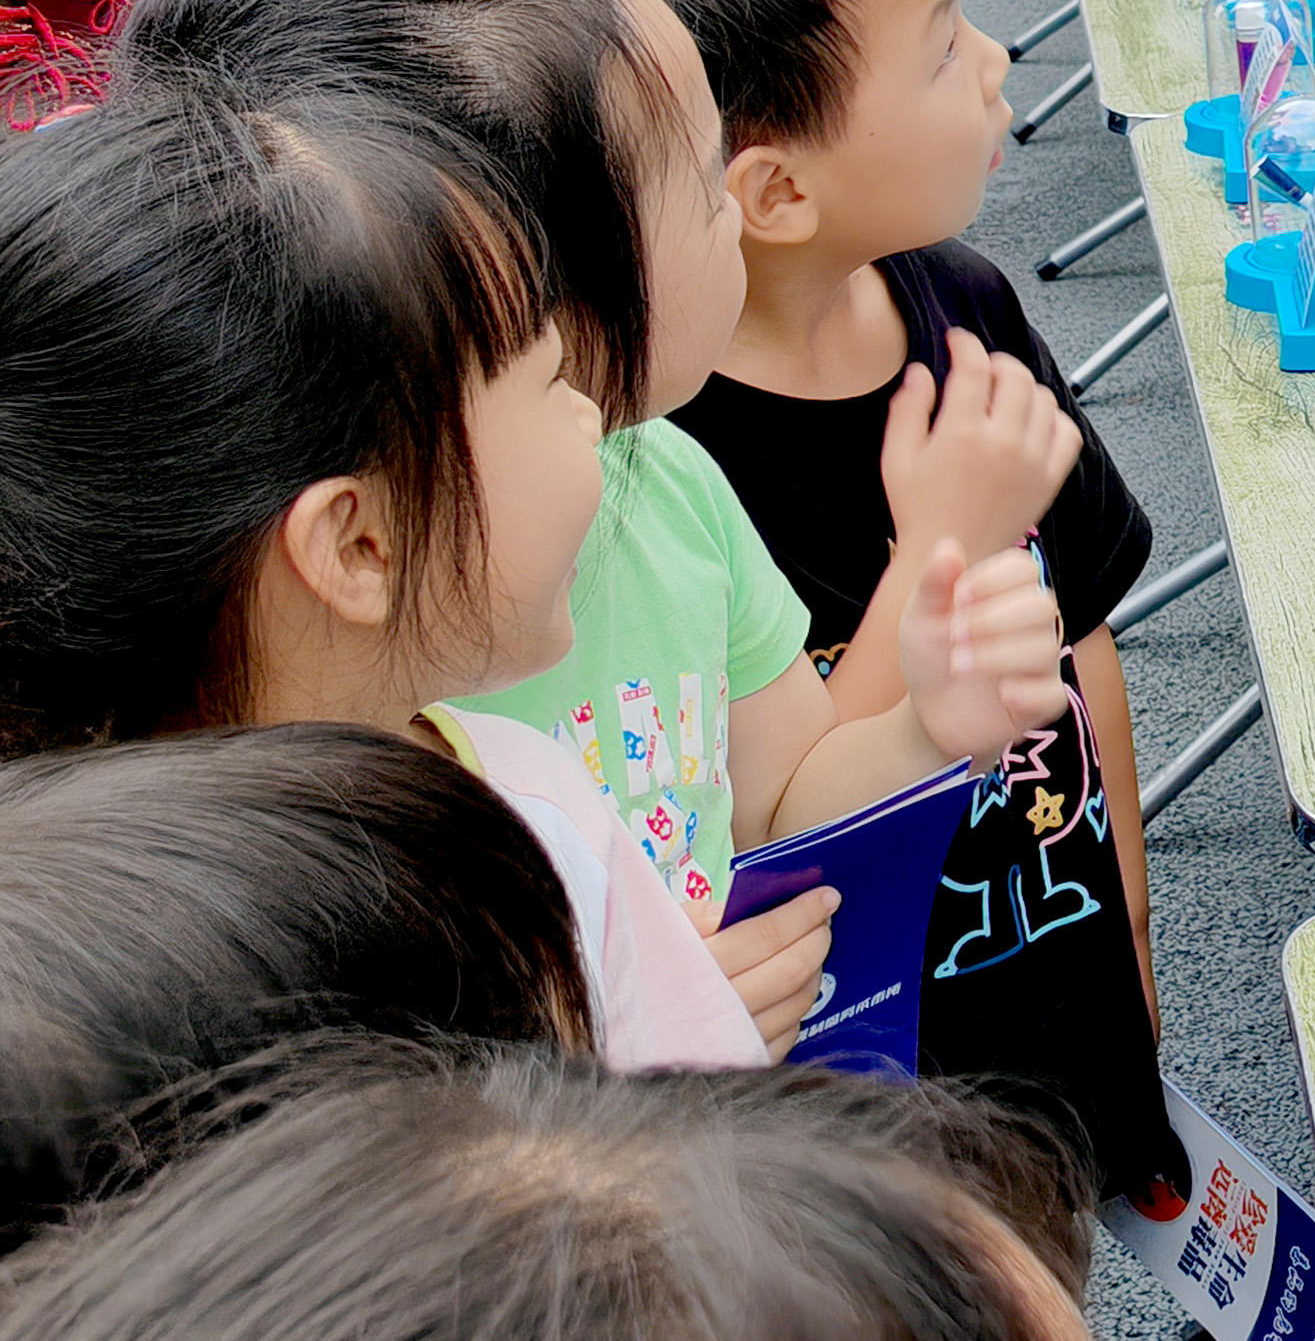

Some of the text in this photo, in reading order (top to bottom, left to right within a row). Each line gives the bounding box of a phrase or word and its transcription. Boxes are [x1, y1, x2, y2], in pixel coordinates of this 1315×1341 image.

[1177, 1158, 1239, 1283] 远离毒品
[1208, 1189, 1269, 1311] 珍爱生命
